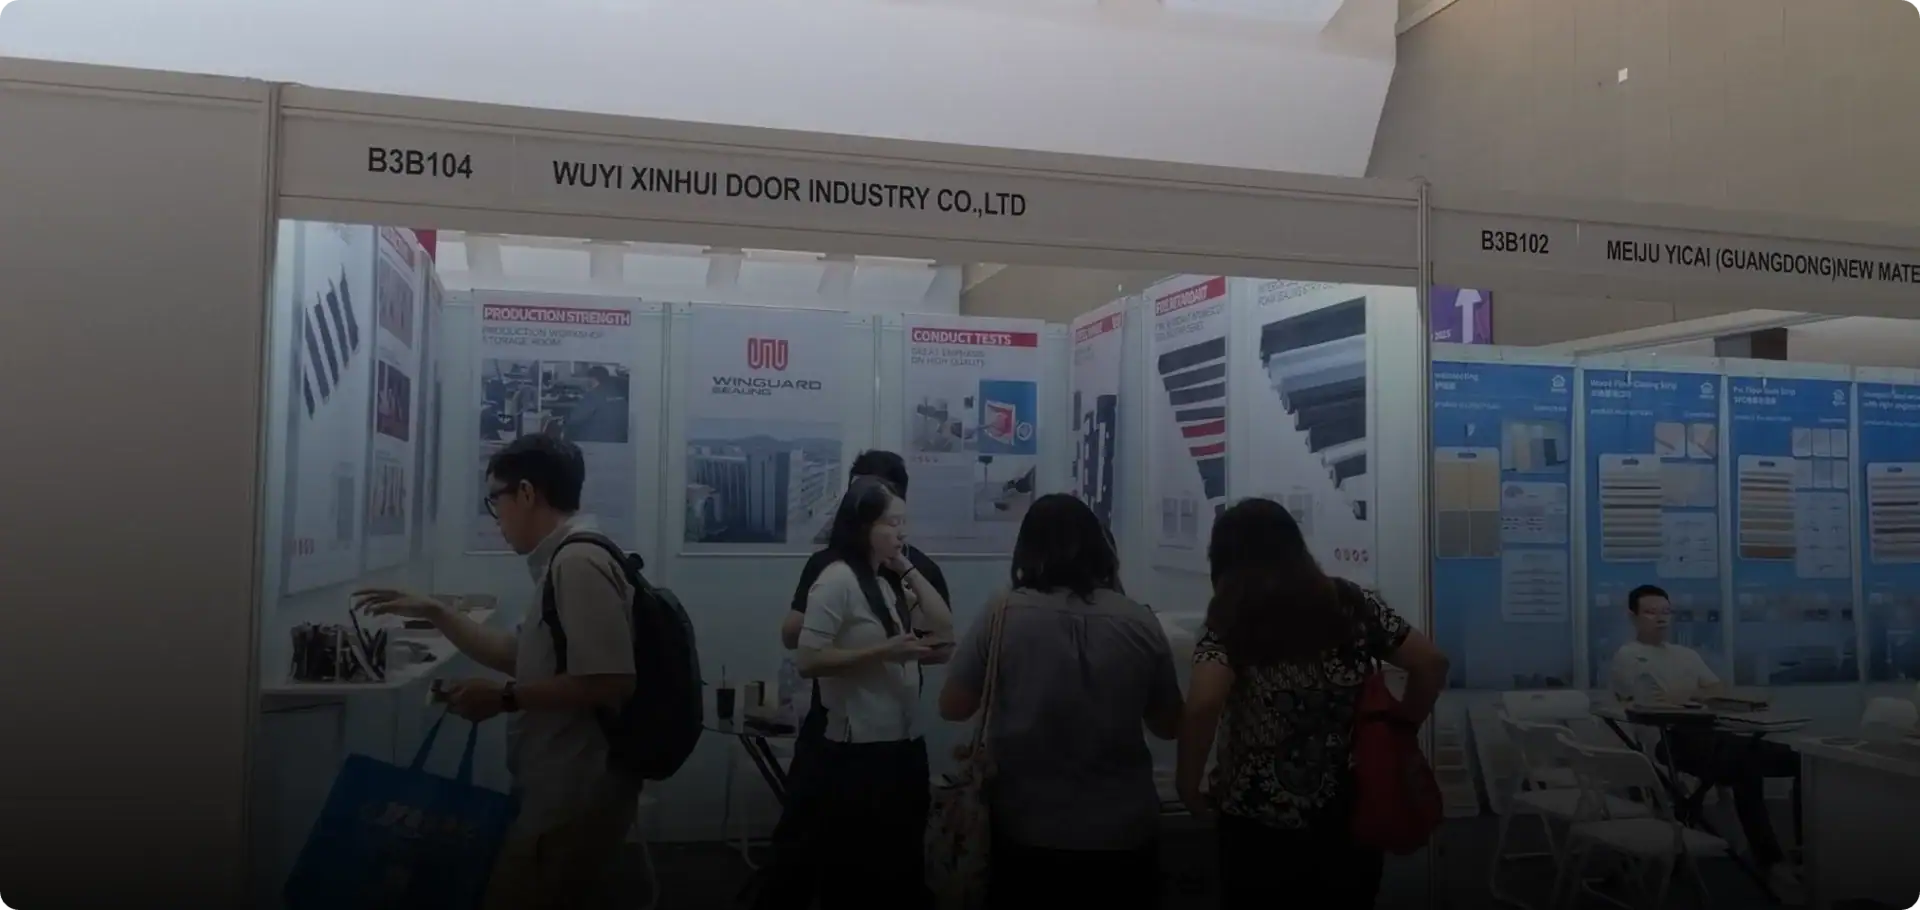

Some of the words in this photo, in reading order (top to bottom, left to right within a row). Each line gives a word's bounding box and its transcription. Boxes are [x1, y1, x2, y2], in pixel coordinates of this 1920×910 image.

[367, 146, 473, 180] B3B104
[553, 160, 622, 189] WUYI
[631, 165, 718, 197] XINHUI
[726, 173, 801, 202] DOOR
[809, 178, 930, 211] INDUSTRY
[937, 188, 1027, 218] CO.,LTD
[1481, 229, 1549, 254] B3B102
[1607, 240, 1661, 264] MEIJU
[1664, 243, 1711, 268] YICAI
[484, 306, 566, 323] PRODUCTION
[567, 310, 631, 326] STRENGTH
[482, 326, 546, 338] PRODUCTION
[482, 335, 527, 346] STORAGE
[531, 337, 562, 346] ROOM
[913, 330, 970, 345] CONDUCT
[973, 332, 1012, 346] TESTS
[712, 376, 823, 391] WINGUARD
[712, 387, 772, 397] SEALING
